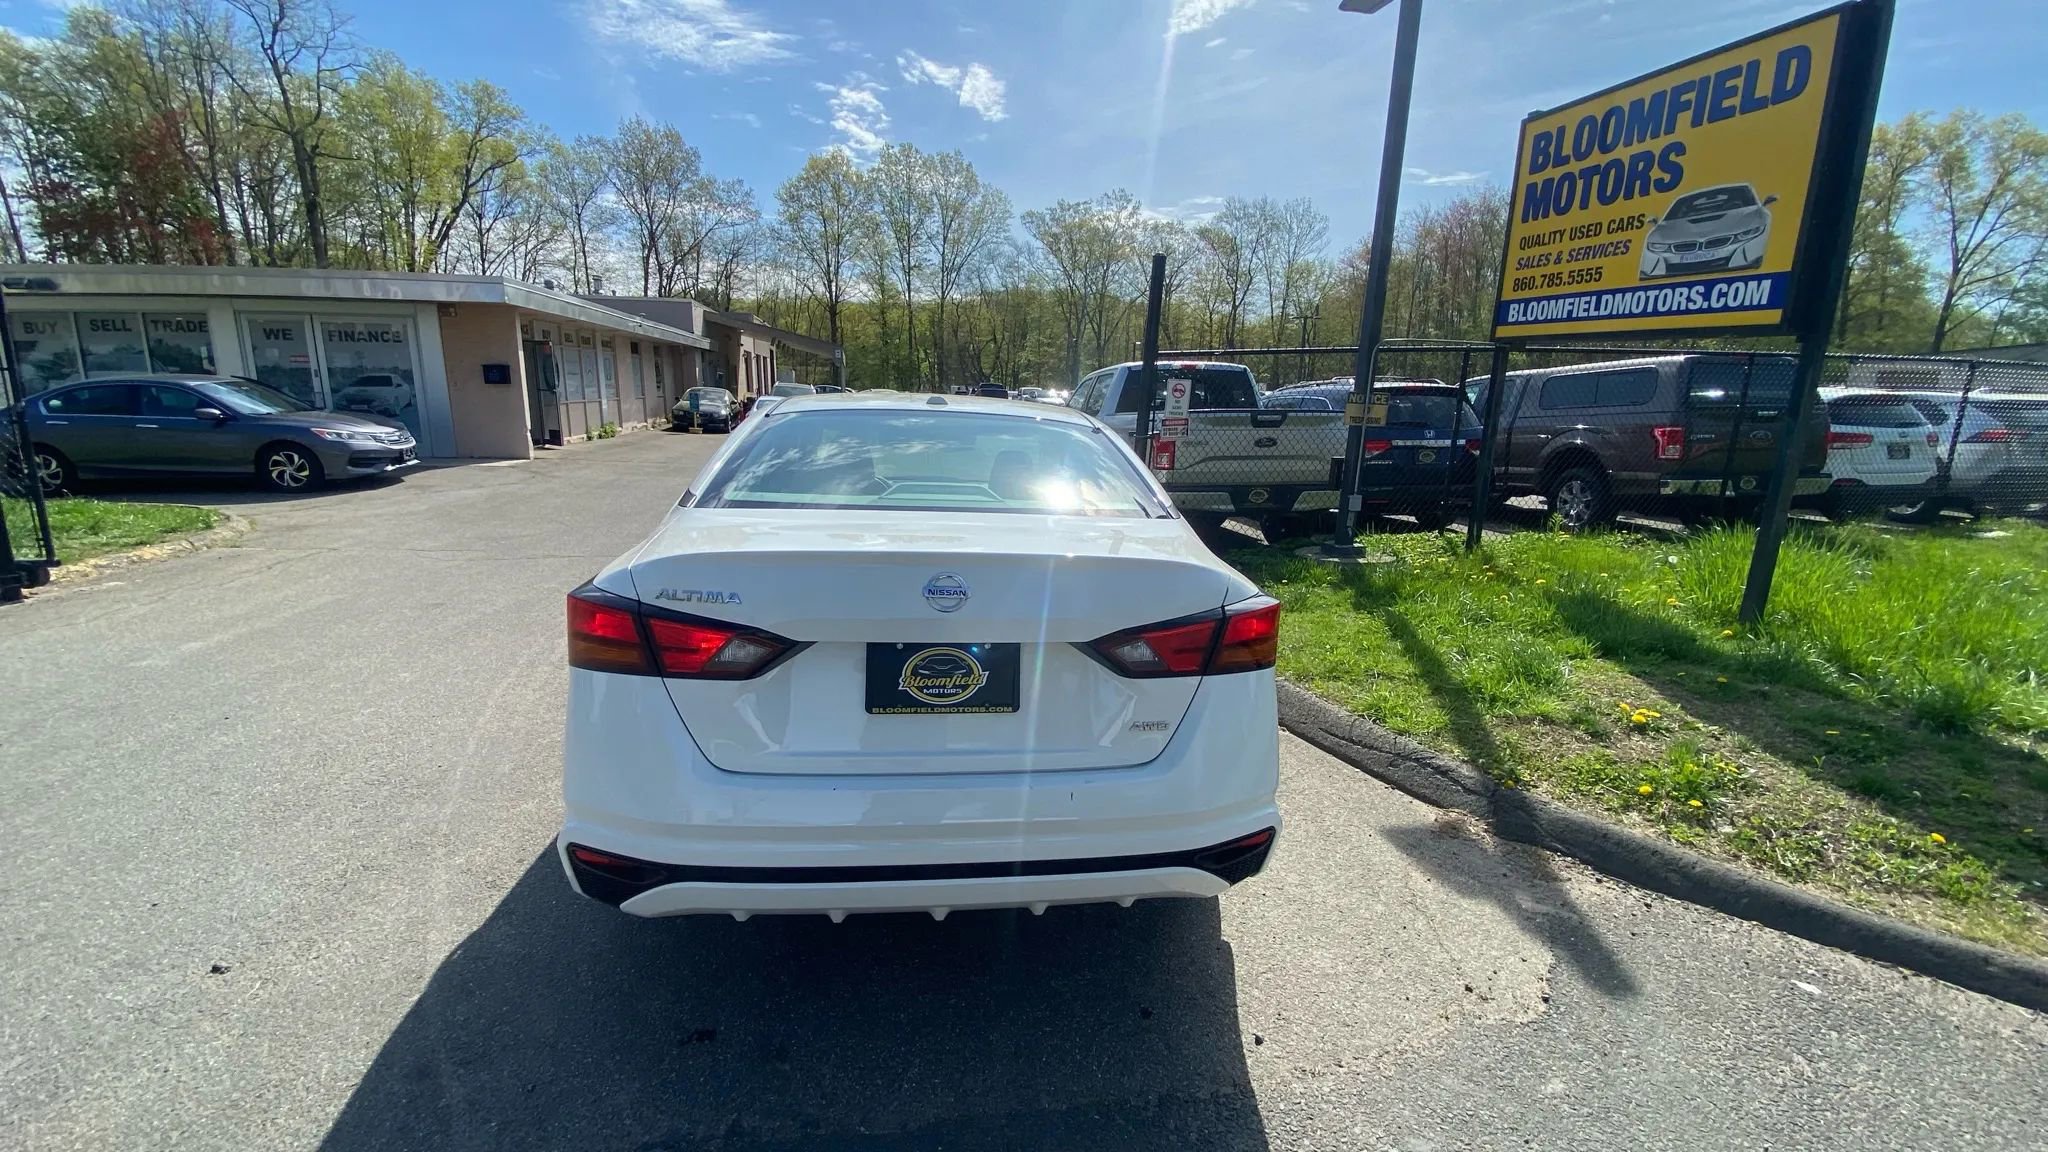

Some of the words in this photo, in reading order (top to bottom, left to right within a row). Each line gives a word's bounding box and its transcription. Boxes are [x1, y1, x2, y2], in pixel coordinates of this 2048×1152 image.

[1528, 45, 1812, 175] BLOOMFIELD
[1521, 141, 1687, 223] MOTORS
[1519, 228, 1566, 251] QUALITY
[1569, 221, 1603, 242] USED
[1606, 213, 1646, 235] CARS
[1515, 252, 1552, 271] SALES
[1553, 250, 1564, 266] &
[1566, 239, 1632, 263] SERVICES
[1512, 266, 1603, 292] 860.785.5555
[1507, 279, 1772, 323] BLOOMFIELDMOTORS.COM
[22, 321, 58, 334] BUY
[89, 319, 133, 332] SELL
[150, 319, 208, 333] TRADE
[262, 327, 295, 341] WE
[327, 329, 403, 343] FINANCE
[1349, 393, 1388, 404] NOICE
[655, 588, 742, 604] ALTIMA
[927, 588, 967, 597] NISSAN
[903, 673, 983, 689] Bloomfield
[872, 706, 1013, 714] BLOOMFIELDMOTORS.COM
